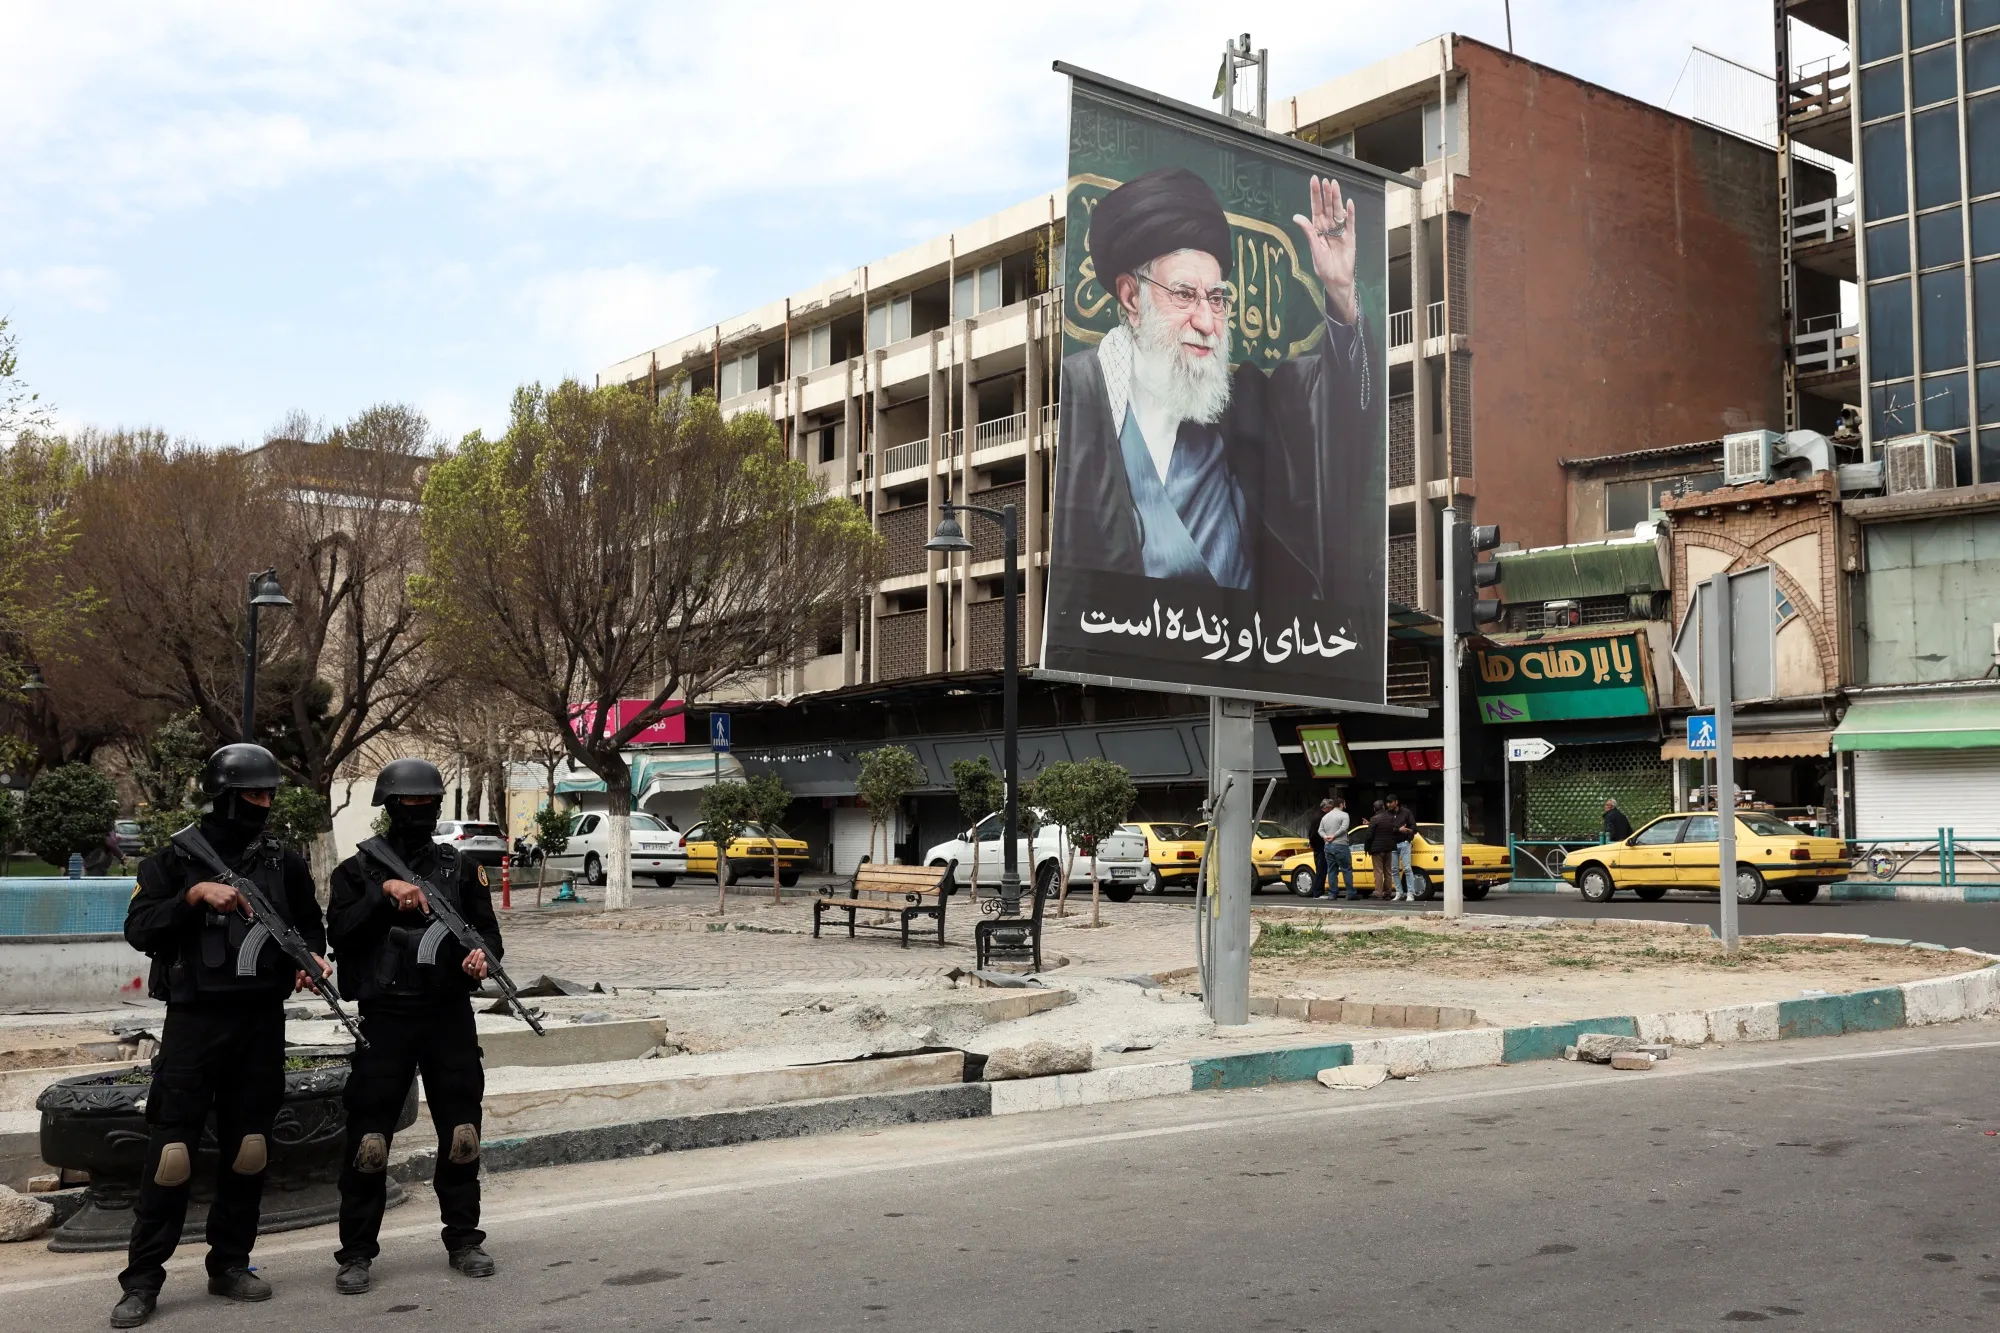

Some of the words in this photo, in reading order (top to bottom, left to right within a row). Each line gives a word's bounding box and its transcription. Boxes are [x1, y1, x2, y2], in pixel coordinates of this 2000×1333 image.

[1080, 598, 1161, 637] است
[1165, 606, 1230, 661] زنده
[1225, 611, 1262, 662] او
[1263, 616, 1358, 664] خدای
